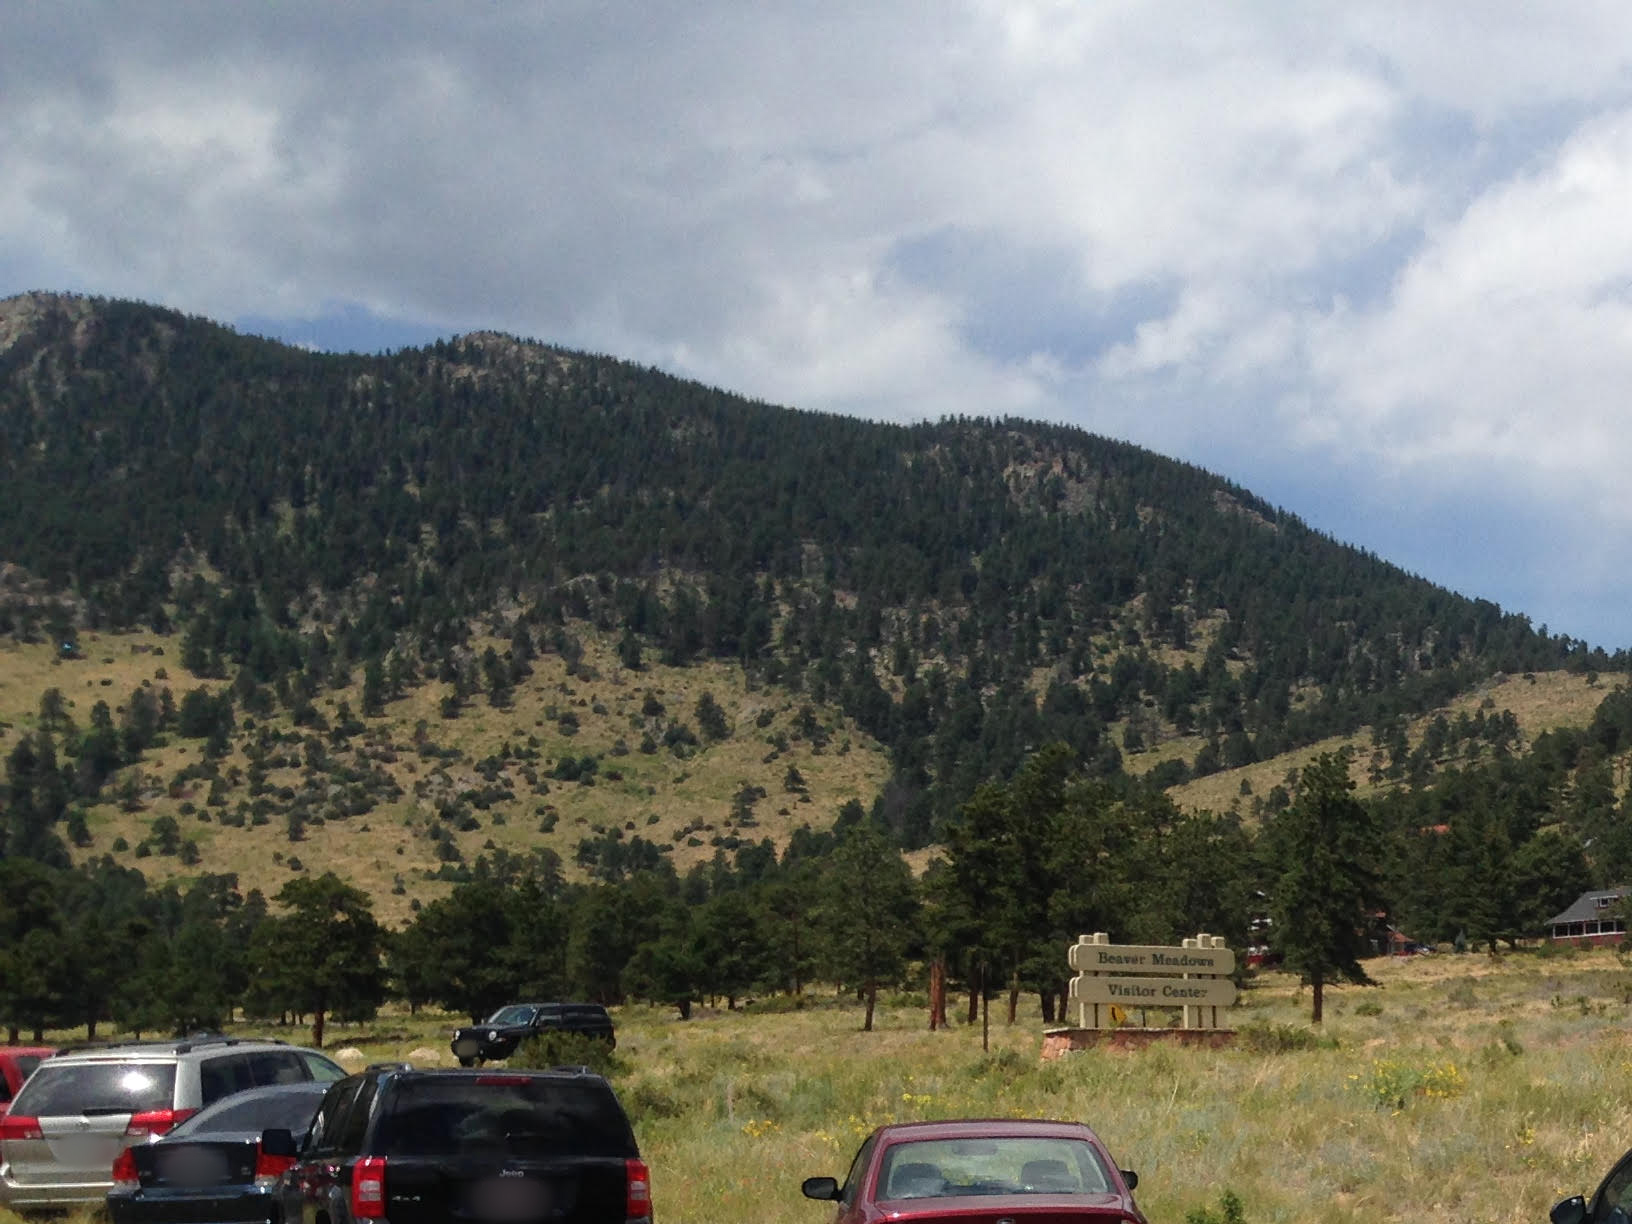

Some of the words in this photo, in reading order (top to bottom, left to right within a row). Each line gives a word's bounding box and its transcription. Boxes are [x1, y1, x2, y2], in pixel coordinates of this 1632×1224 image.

[1098, 952, 1146, 965] Beaver
[1152, 953, 1214, 967] Meadows
[1108, 983, 1156, 997] Visitor
[1162, 985, 1208, 998] Center
